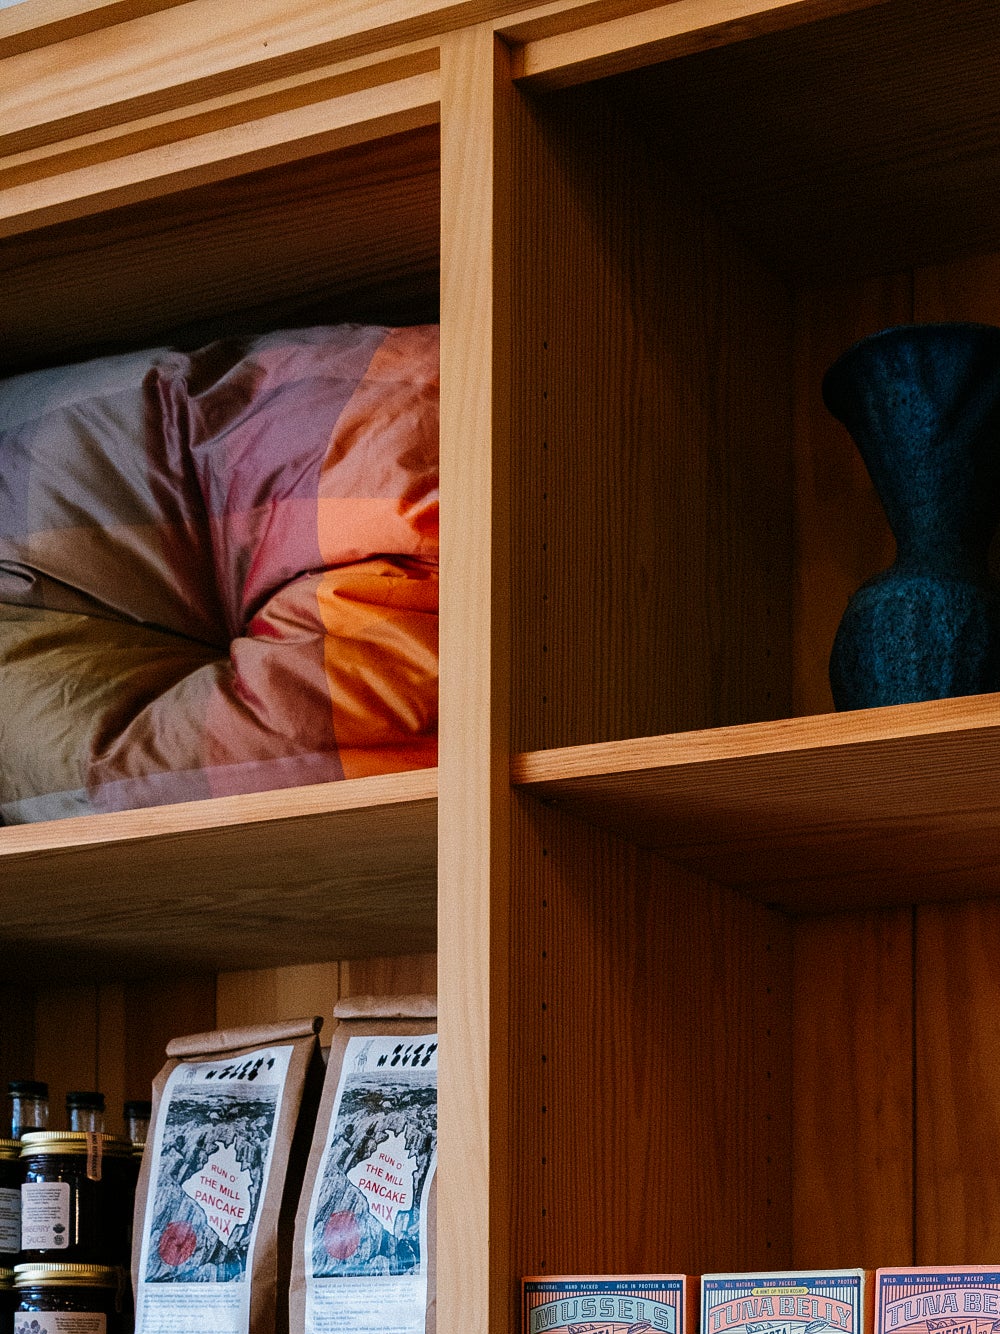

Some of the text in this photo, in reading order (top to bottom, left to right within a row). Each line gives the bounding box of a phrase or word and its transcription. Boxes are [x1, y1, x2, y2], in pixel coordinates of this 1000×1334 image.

[379, 1153, 395, 1165] RUN
[212, 1164, 227, 1178] RUN
[366, 1164, 404, 1186] THE MILL
[200, 1176, 240, 1200] THE MILL
[359, 1178, 406, 1204] PANCAKE
[195, 1190, 245, 1218] PANCAKE
[371, 1202, 393, 1223] MIX
[210, 1216, 231, 1235] MIX
[535, 1298, 668, 1330] MUSSELS
[887, 1293, 958, 1326] TUNA
